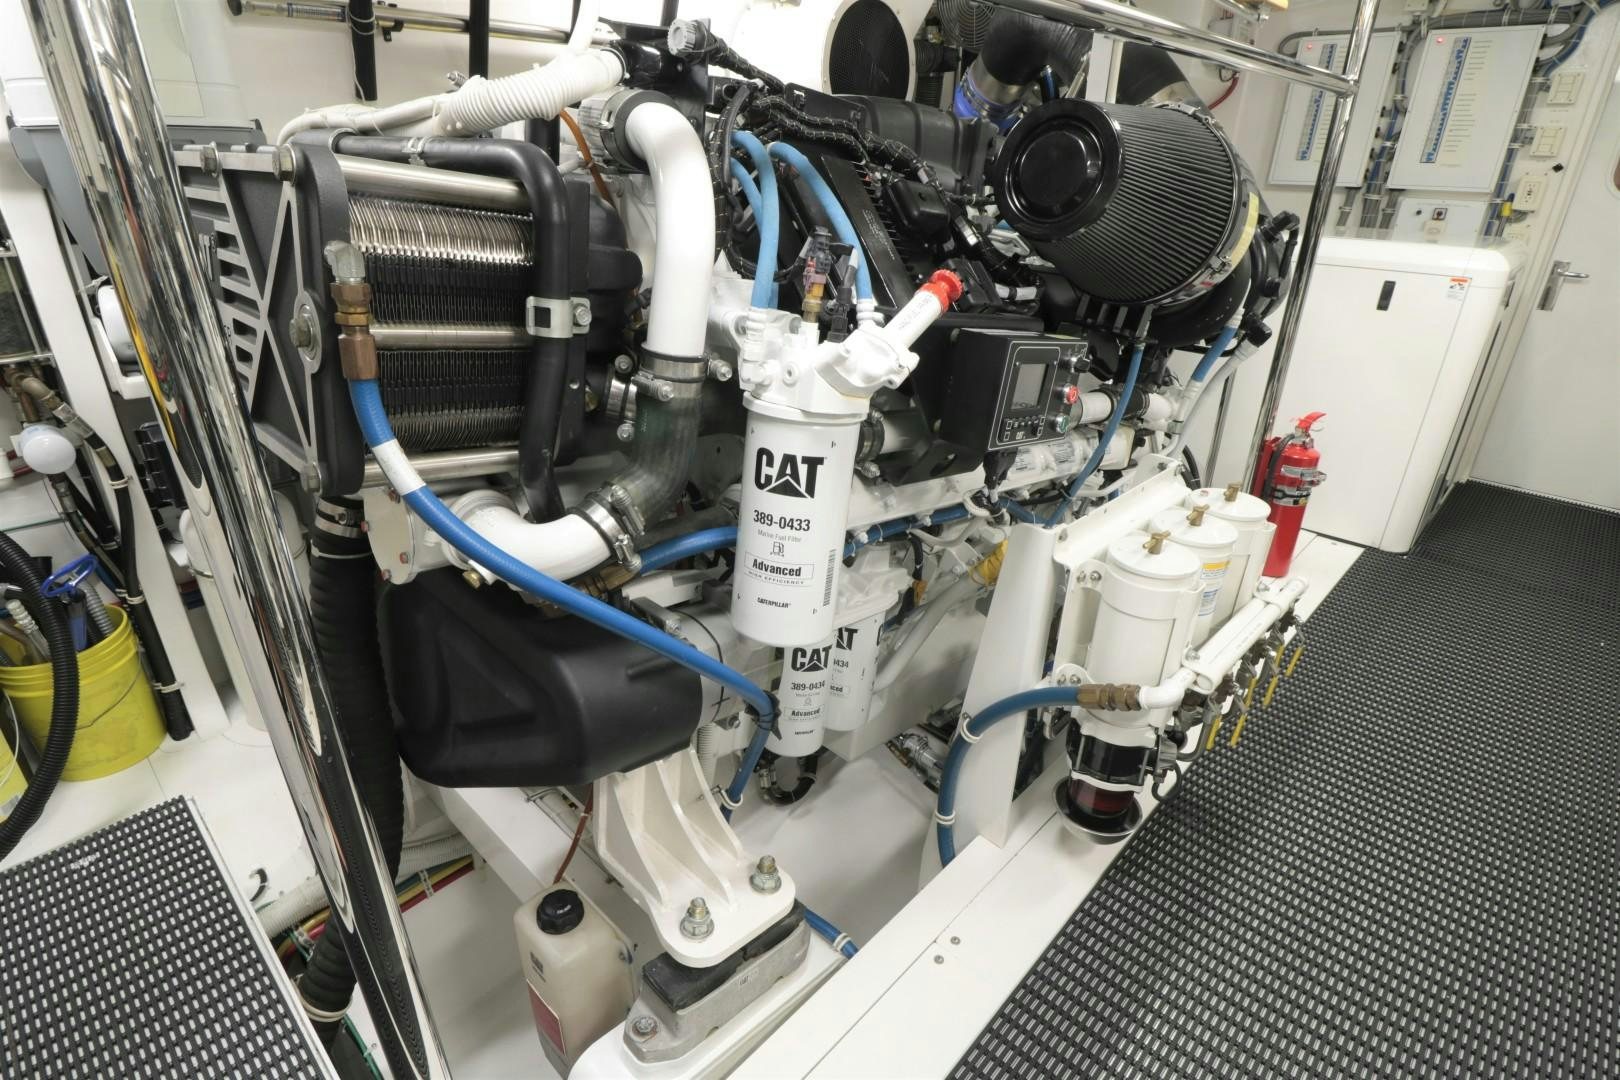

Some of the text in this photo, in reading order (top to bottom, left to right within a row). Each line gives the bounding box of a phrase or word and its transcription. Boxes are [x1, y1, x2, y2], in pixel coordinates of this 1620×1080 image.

[755, 447, 825, 499] CAT
[753, 509, 811, 532] 389-0433
[752, 558, 802, 577] Advanced
[791, 645, 832, 673] CAT
